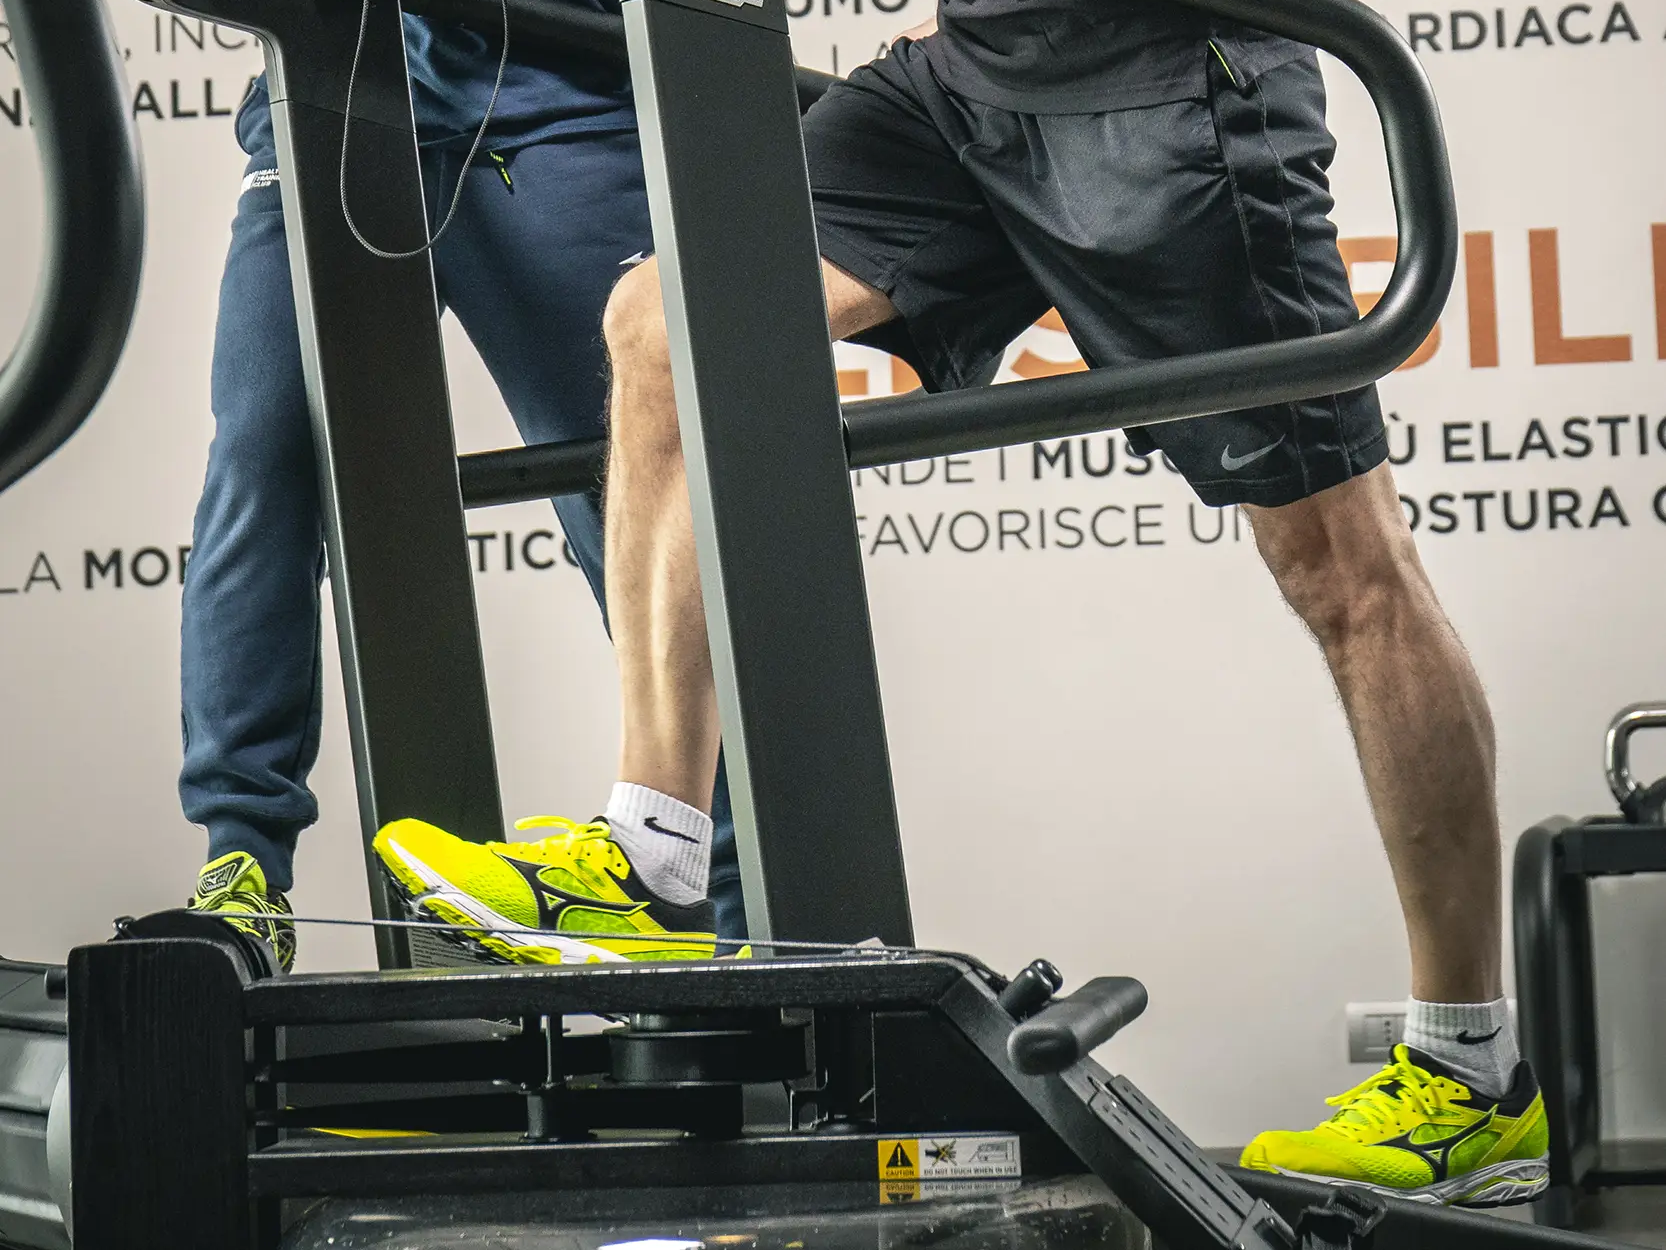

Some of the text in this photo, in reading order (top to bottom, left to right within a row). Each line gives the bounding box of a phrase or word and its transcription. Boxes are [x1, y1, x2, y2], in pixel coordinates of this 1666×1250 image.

[154, 12, 260, 53] INC
[1442, 413, 1666, 464] ELASTI
[0, 551, 62, 594] A
